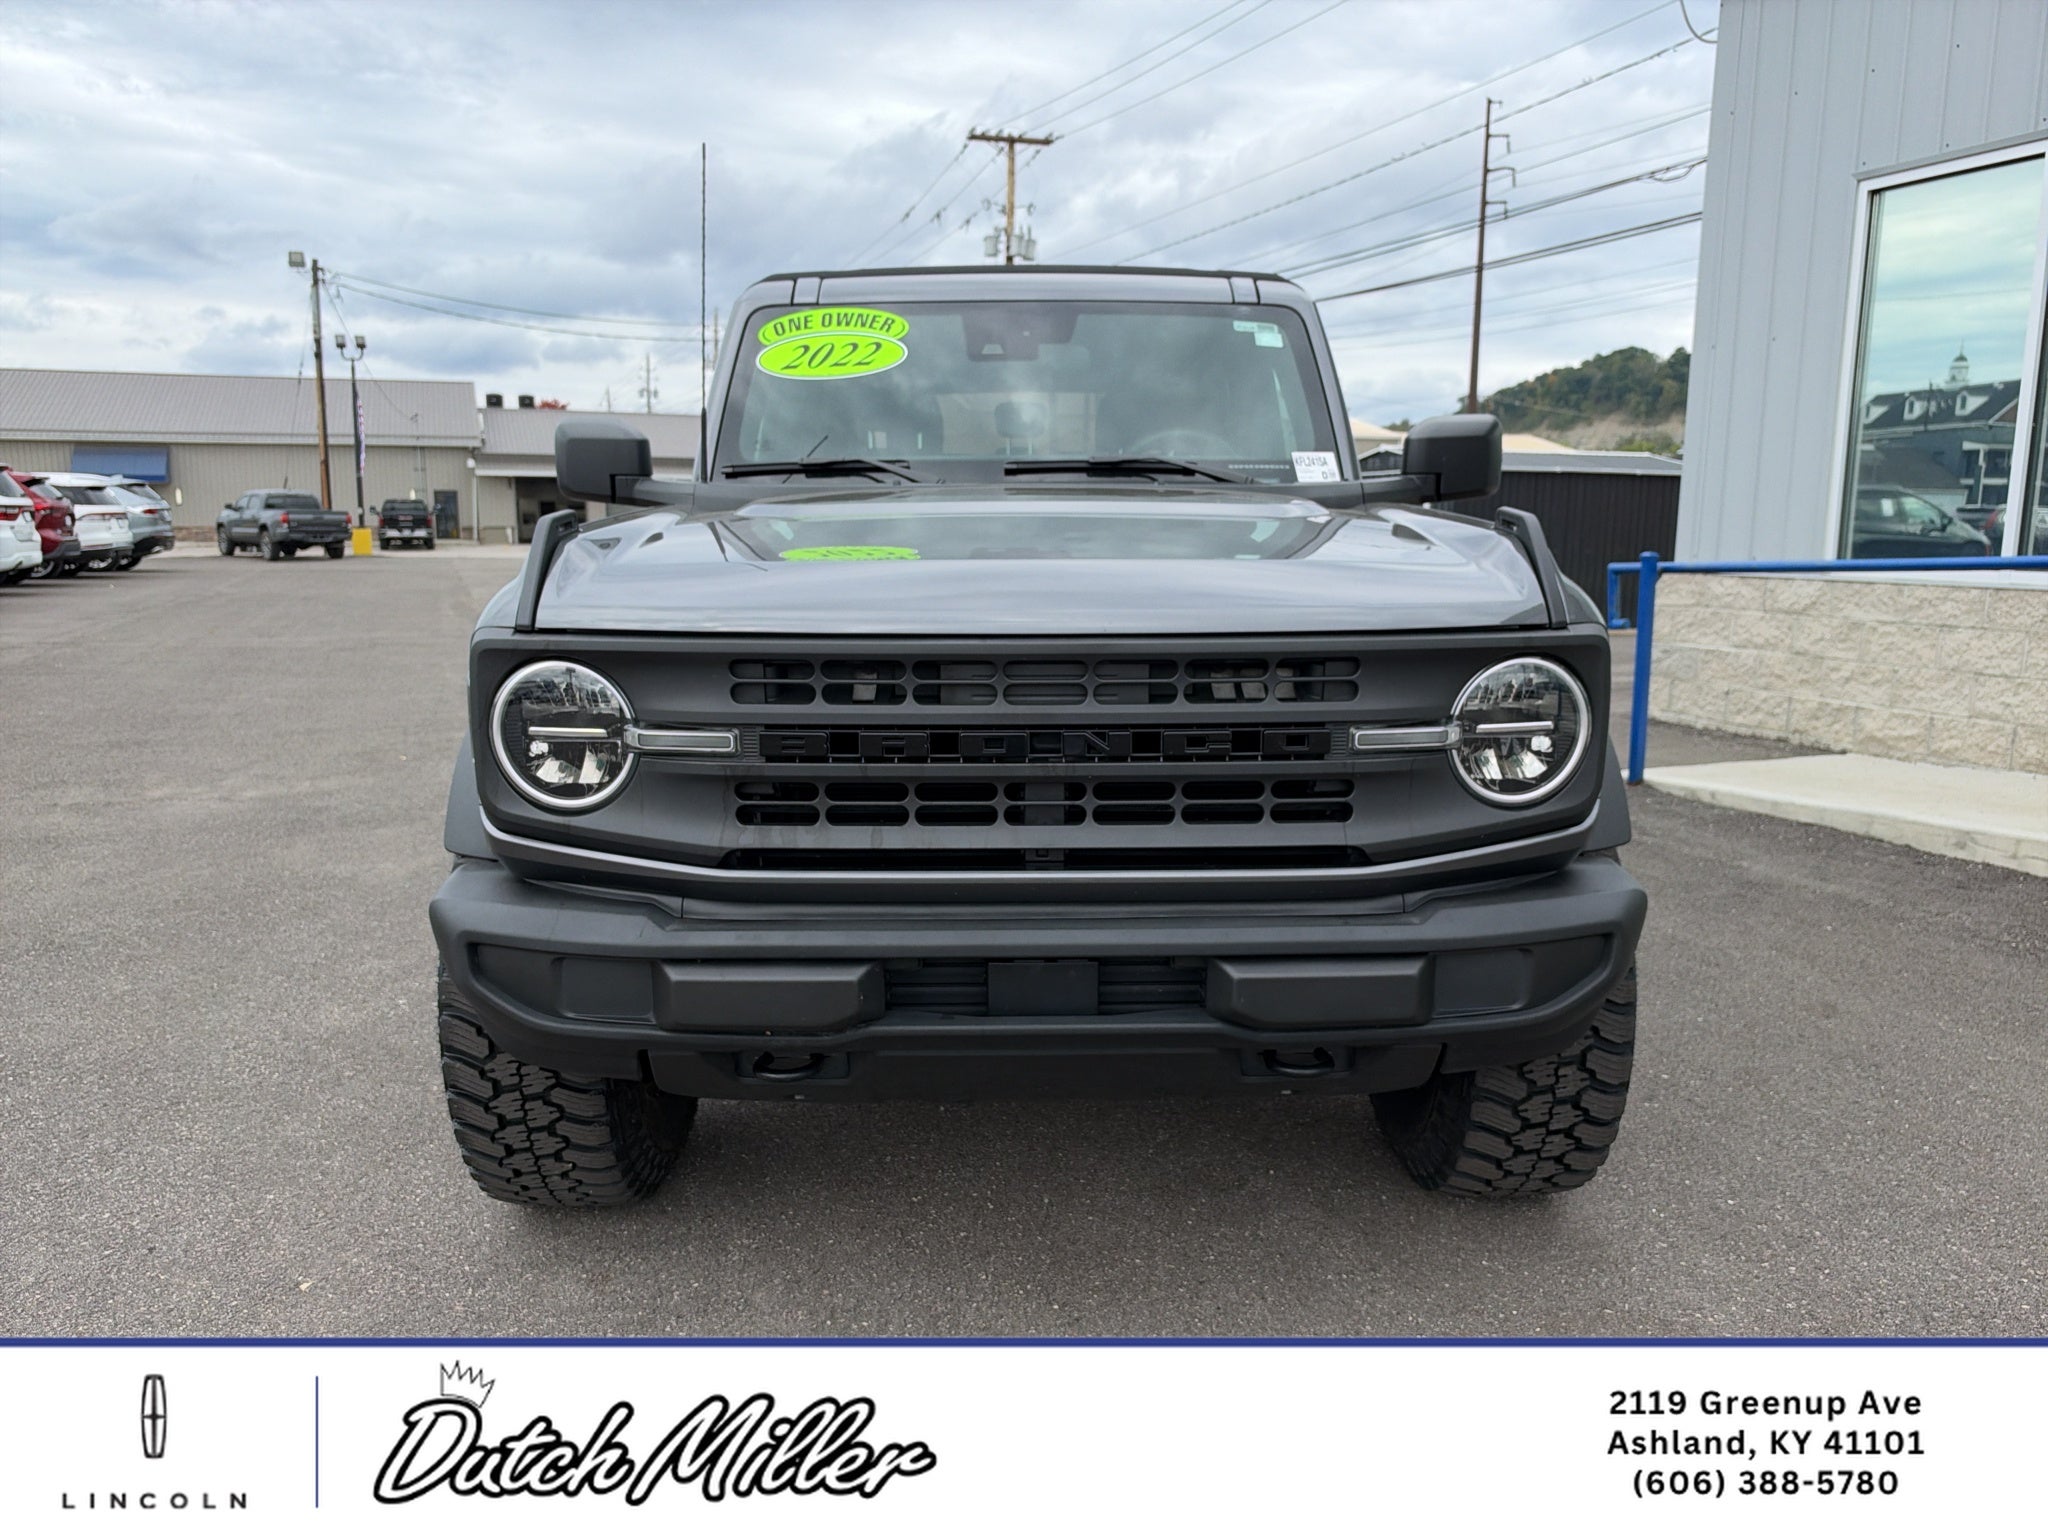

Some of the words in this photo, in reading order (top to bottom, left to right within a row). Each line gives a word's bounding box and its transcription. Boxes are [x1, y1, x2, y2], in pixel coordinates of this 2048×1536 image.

[773, 314, 814, 337] ONE
[820, 312, 897, 334] OWNER
[780, 341, 883, 371] 2022
[759, 730, 1330, 758] BRONCO
